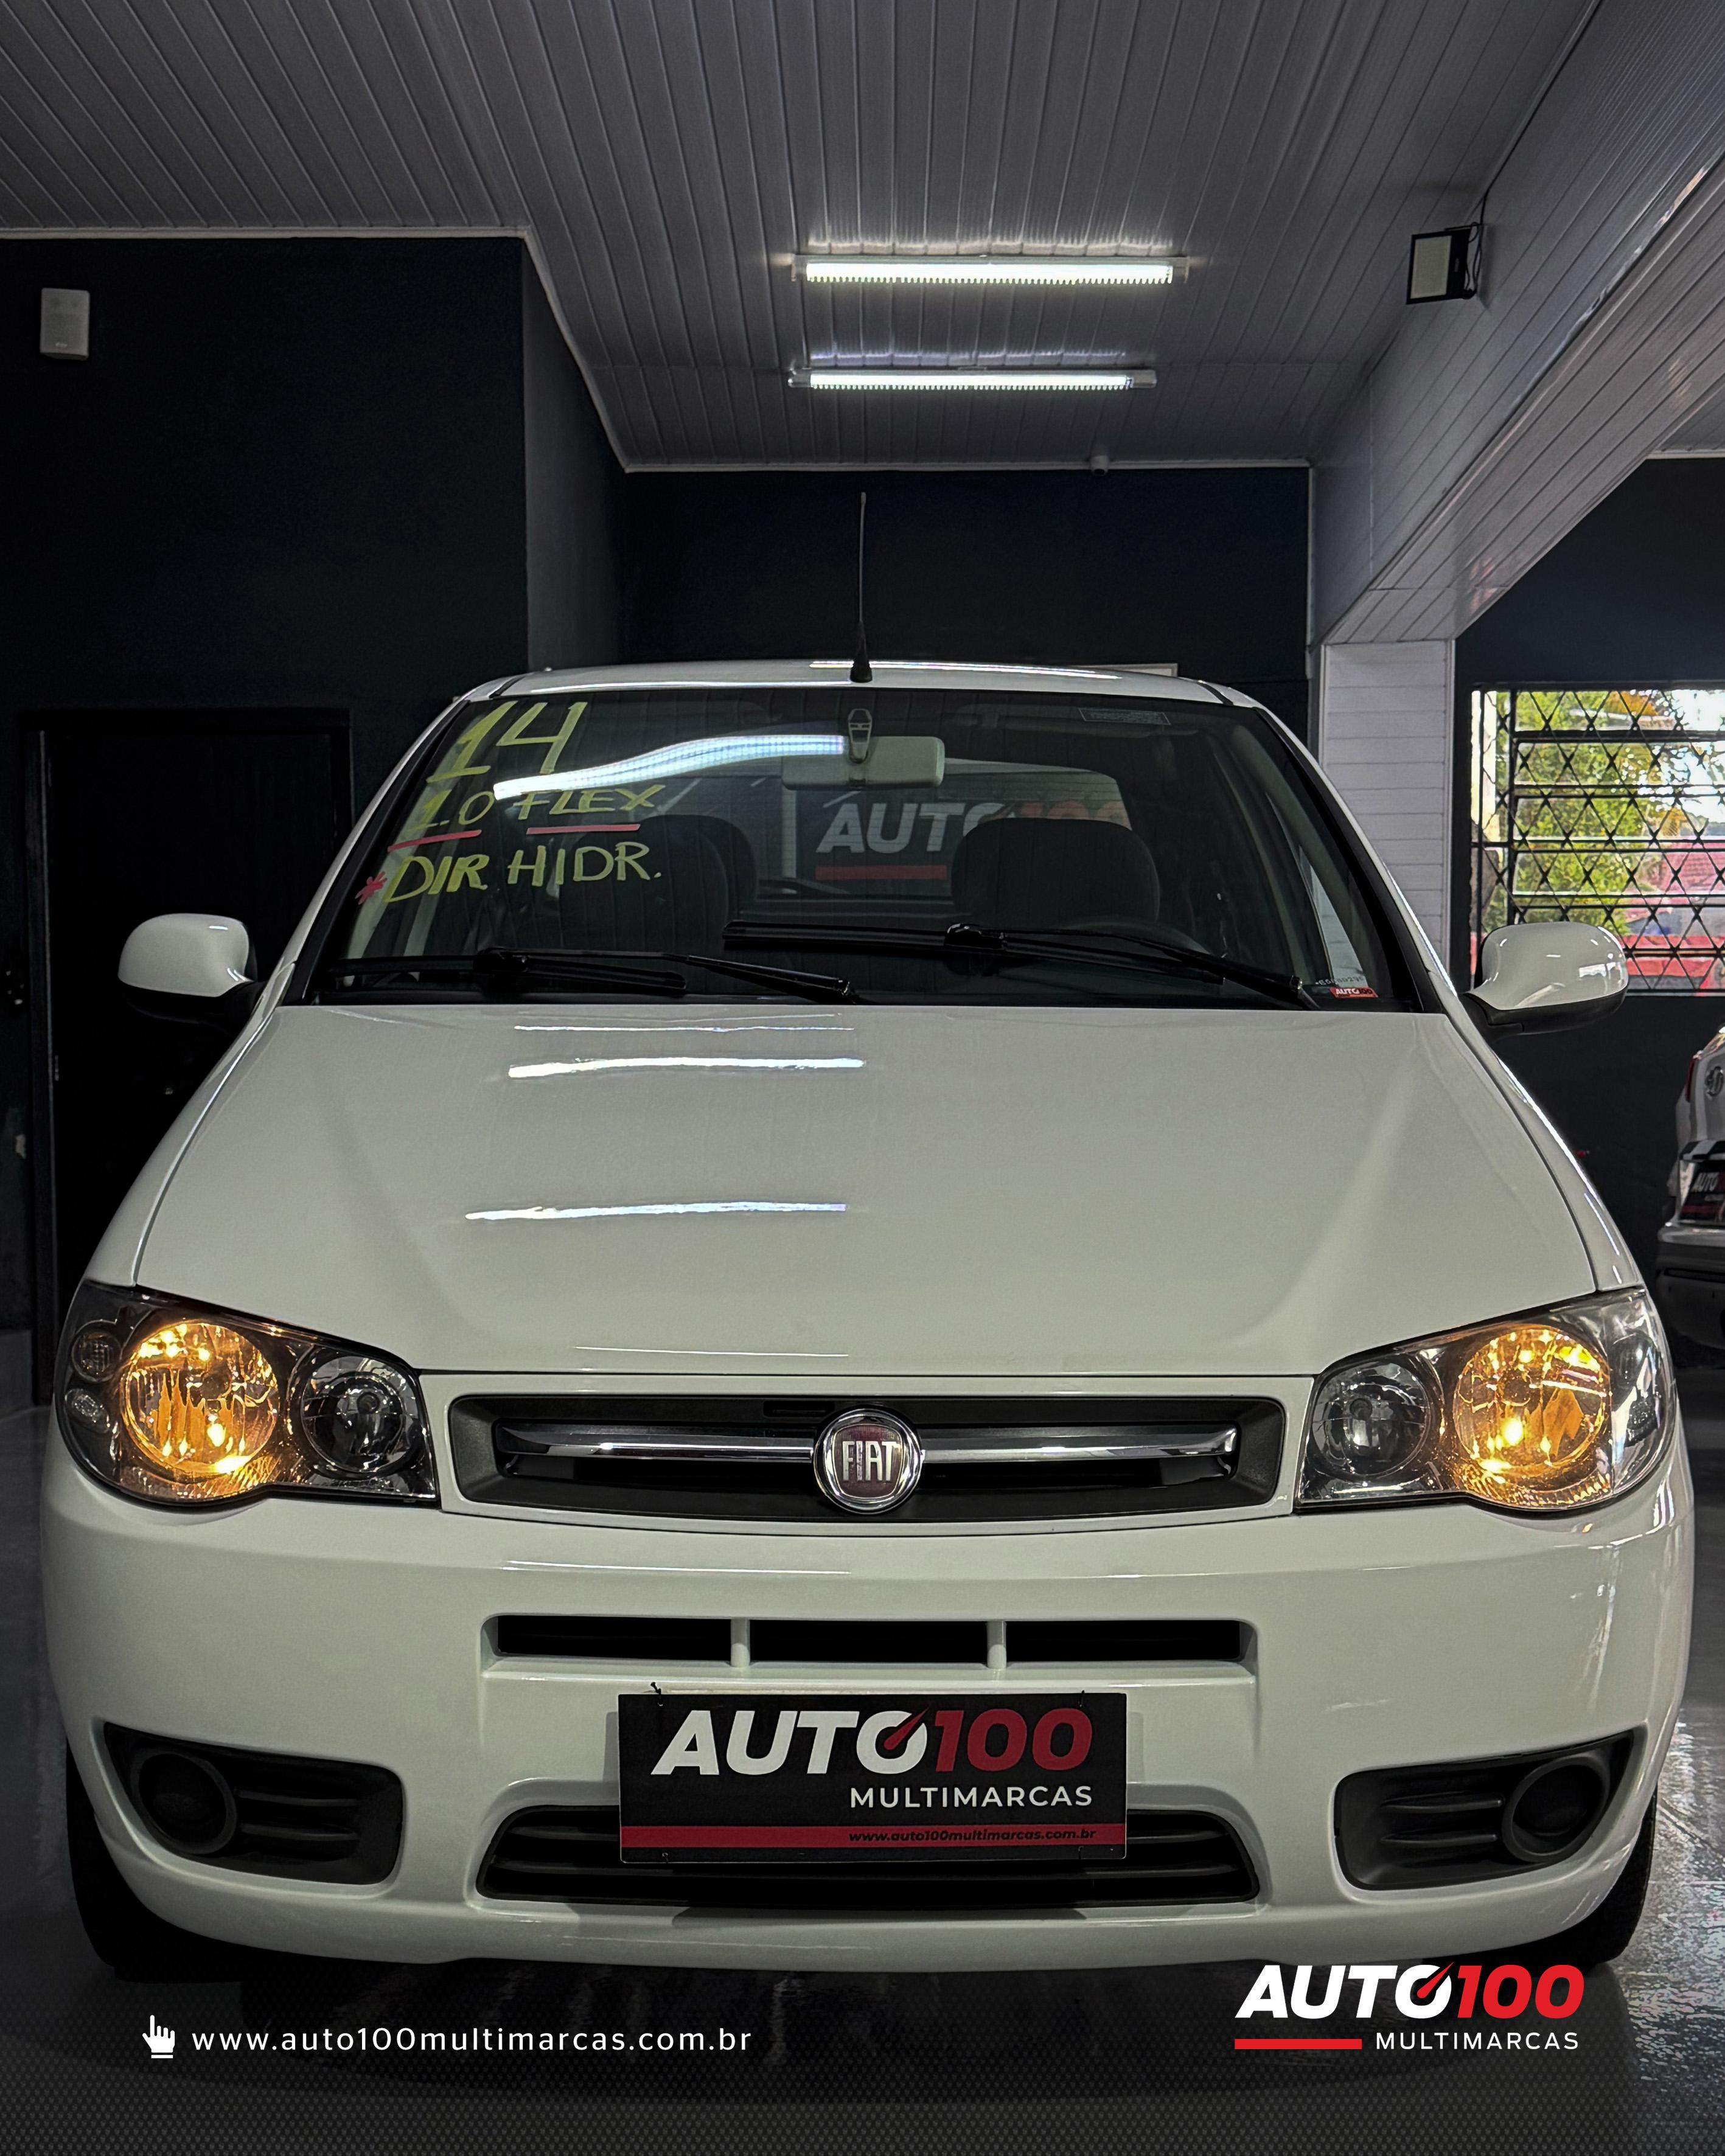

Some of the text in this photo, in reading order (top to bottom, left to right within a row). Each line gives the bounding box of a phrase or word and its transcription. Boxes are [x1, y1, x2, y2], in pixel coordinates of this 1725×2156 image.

[426, 700, 588, 784] 14
[512, 784, 666, 820] FLEX
[507, 841, 662, 886] HIDR.
[842, 1440, 901, 1481] FIAT
[650, 1706, 1093, 1776] AUTO100
[850, 1786, 1093, 1809] MULTIMARCAS
[848, 1828, 1096, 1842] www.auto100multimarcas.com.br
